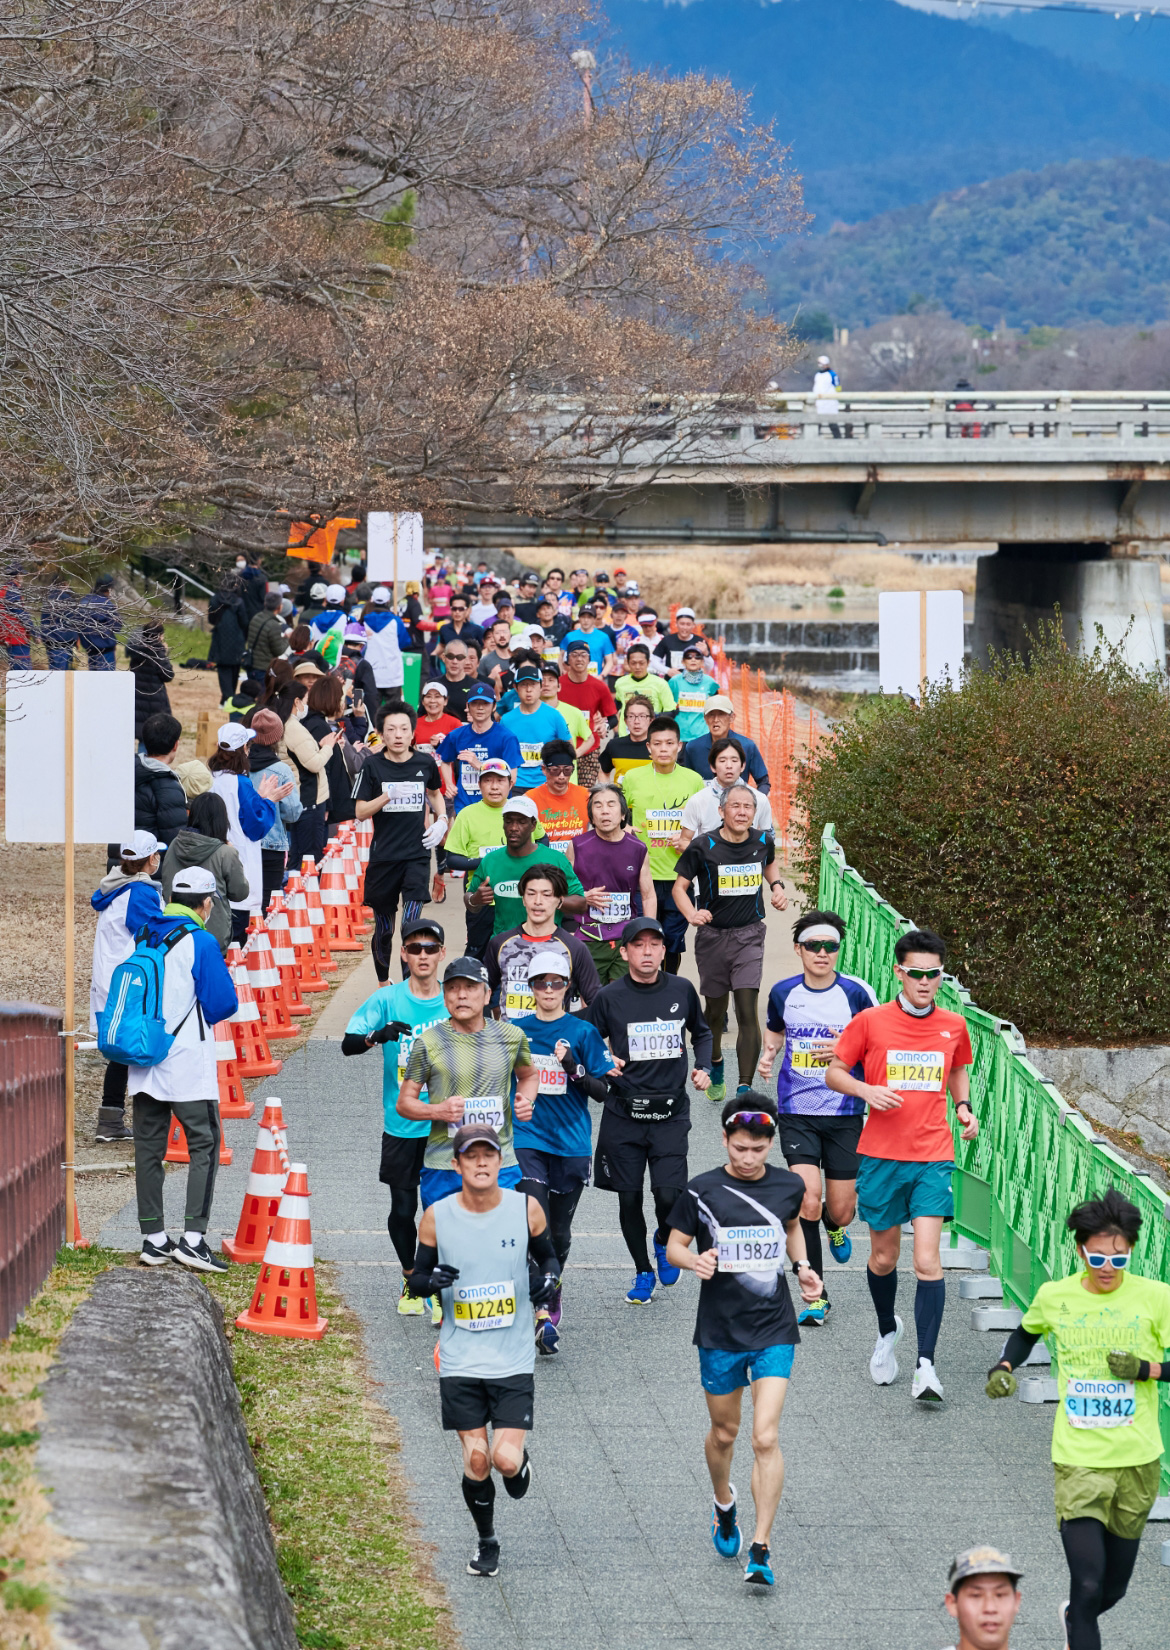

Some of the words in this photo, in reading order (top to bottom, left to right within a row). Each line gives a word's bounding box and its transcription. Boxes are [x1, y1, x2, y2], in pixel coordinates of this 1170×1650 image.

[725, 864, 757, 873] OMRON
[732, 874, 760, 888] 11931
[499, 883, 519, 893] OnP
[507, 966, 529, 981] KIZ
[509, 996, 514, 1005] B
[635, 1022, 675, 1033] OMRON
[786, 1028, 813, 1038] TEAM
[631, 1039, 638, 1047] A
[644, 1034, 680, 1051] 10783
[794, 1054, 800, 1063] B
[896, 1053, 937, 1063] OMRON
[890, 1067, 896, 1076] B
[903, 1066, 942, 1082] 12474
[466, 1099, 496, 1108] MRON
[727, 1228, 775, 1240] OMRON
[721, 1246, 729, 1256] H
[737, 1242, 779, 1261] 19822
[459, 1285, 506, 1299] OMRON
[456, 1304, 463, 1314] B
[469, 1298, 514, 1320] 12249
[1061, 1328, 1136, 1346] OKINAWA
[1075, 1382, 1126, 1394] OMRON
[1068, 1399, 1076, 1411] C
[1084, 1398, 1135, 1417] 13842
